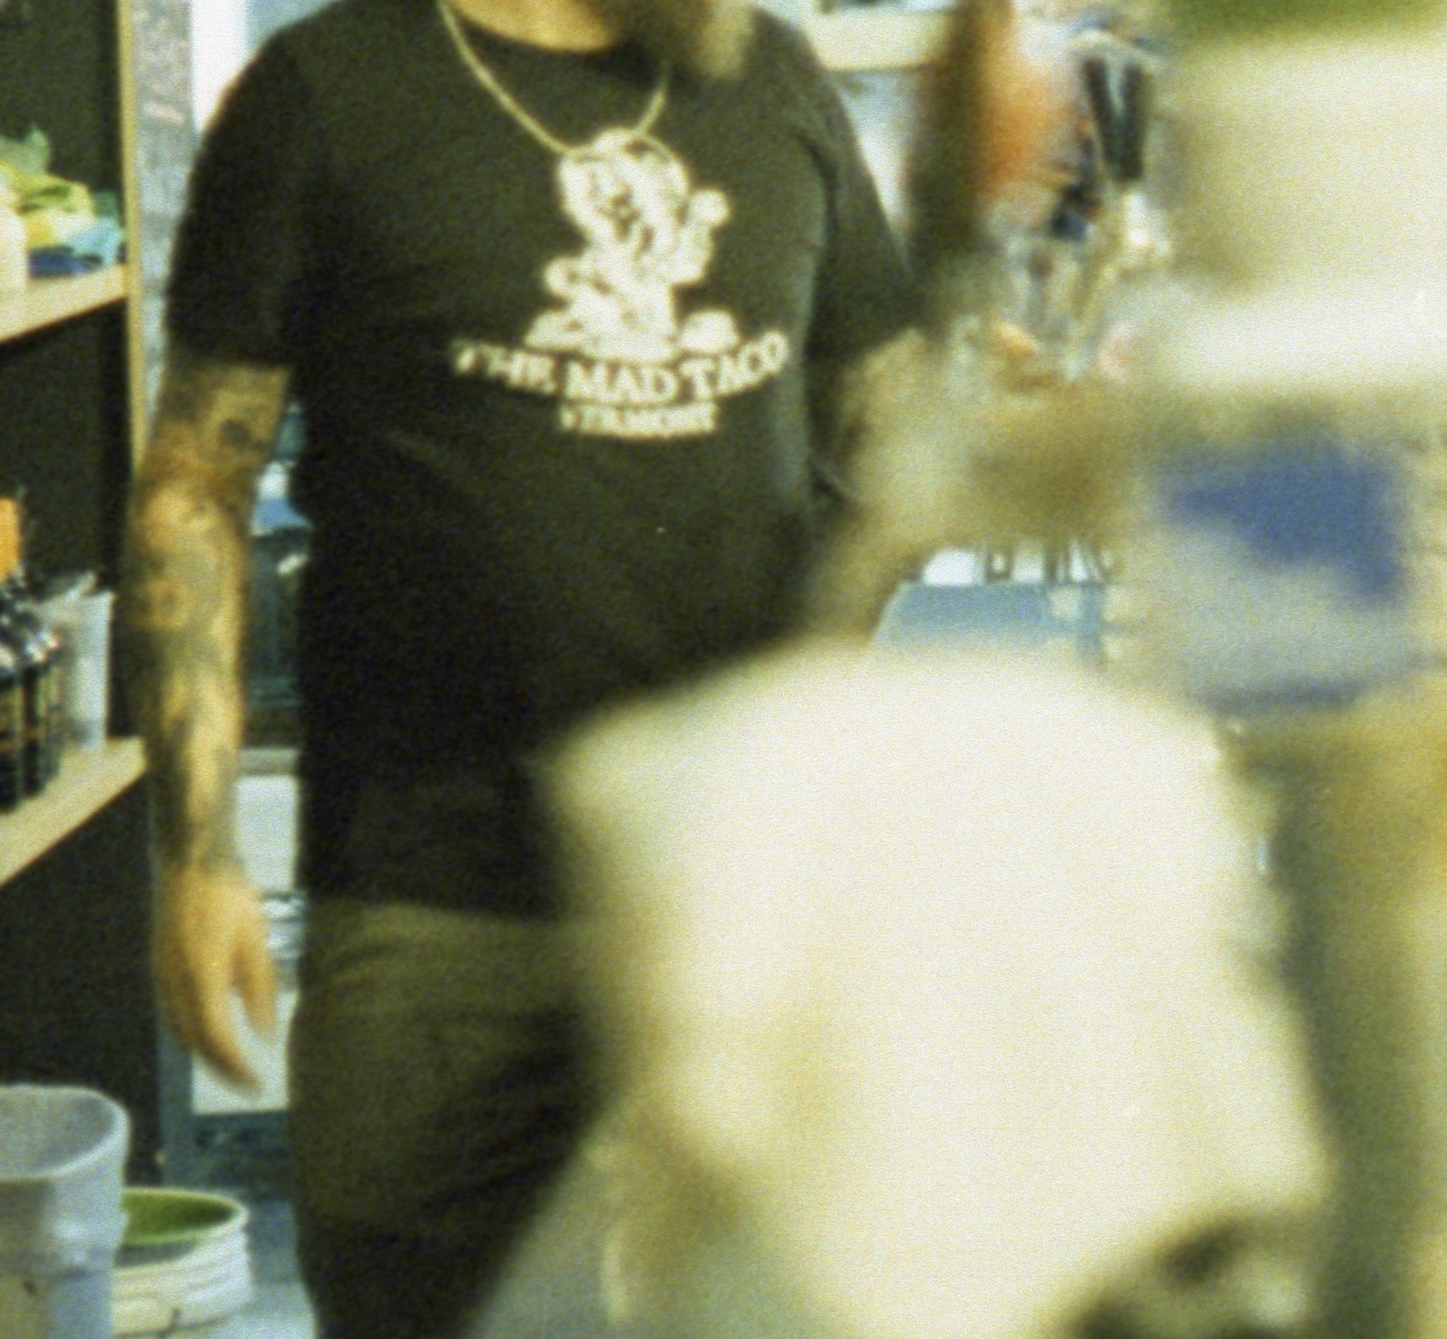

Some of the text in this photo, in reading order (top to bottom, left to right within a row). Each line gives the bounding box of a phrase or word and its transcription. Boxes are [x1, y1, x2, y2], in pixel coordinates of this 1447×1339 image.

[456, 330, 790, 405] THE MAD TACO
